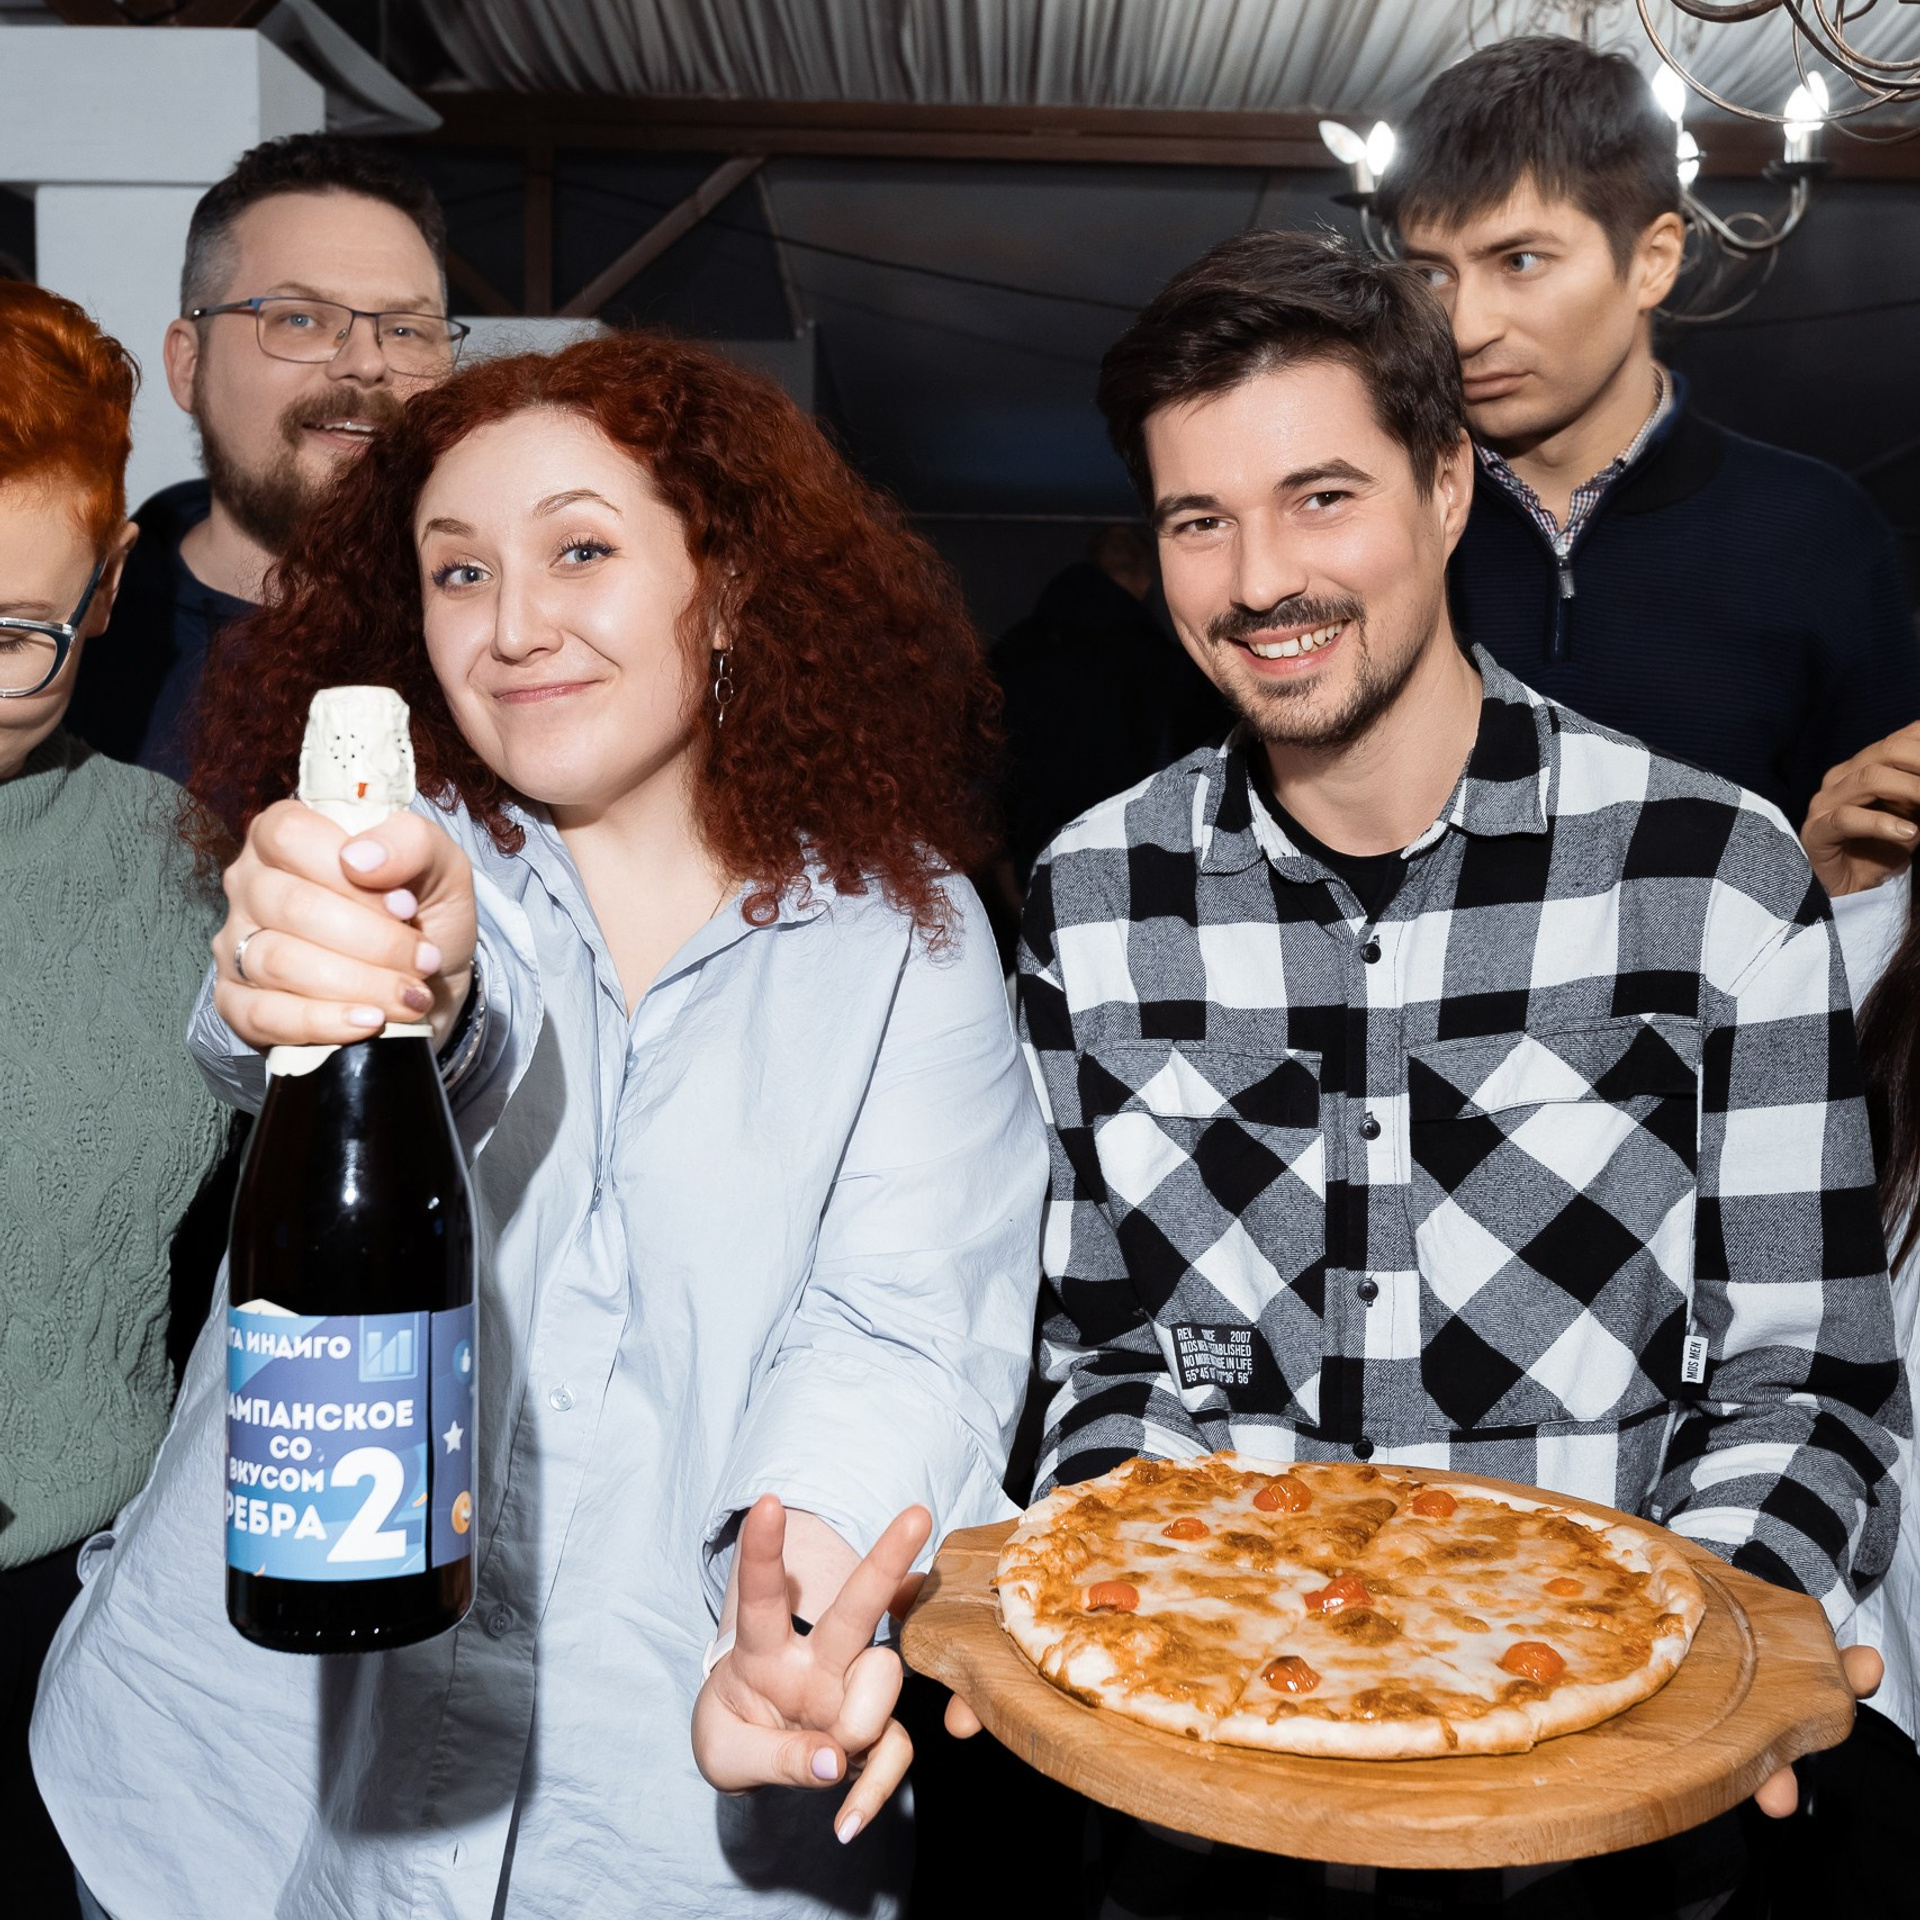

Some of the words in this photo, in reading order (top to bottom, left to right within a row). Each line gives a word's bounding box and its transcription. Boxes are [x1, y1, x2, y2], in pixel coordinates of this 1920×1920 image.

[246, 1331, 351, 1360] ИНДИГО
[1230, 1330, 1250, 1344] 2007
[1688, 1340, 1702, 1360] MEN
[1182, 1354, 1194, 1368] NO
[1236, 1358, 1252, 1370] LIFE
[228, 1394, 414, 1431] АМПАНСКОЕ
[269, 1435, 313, 1461] СО
[229, 1456, 325, 1493] ВКУСОМ
[326, 1446, 407, 1563] 2
